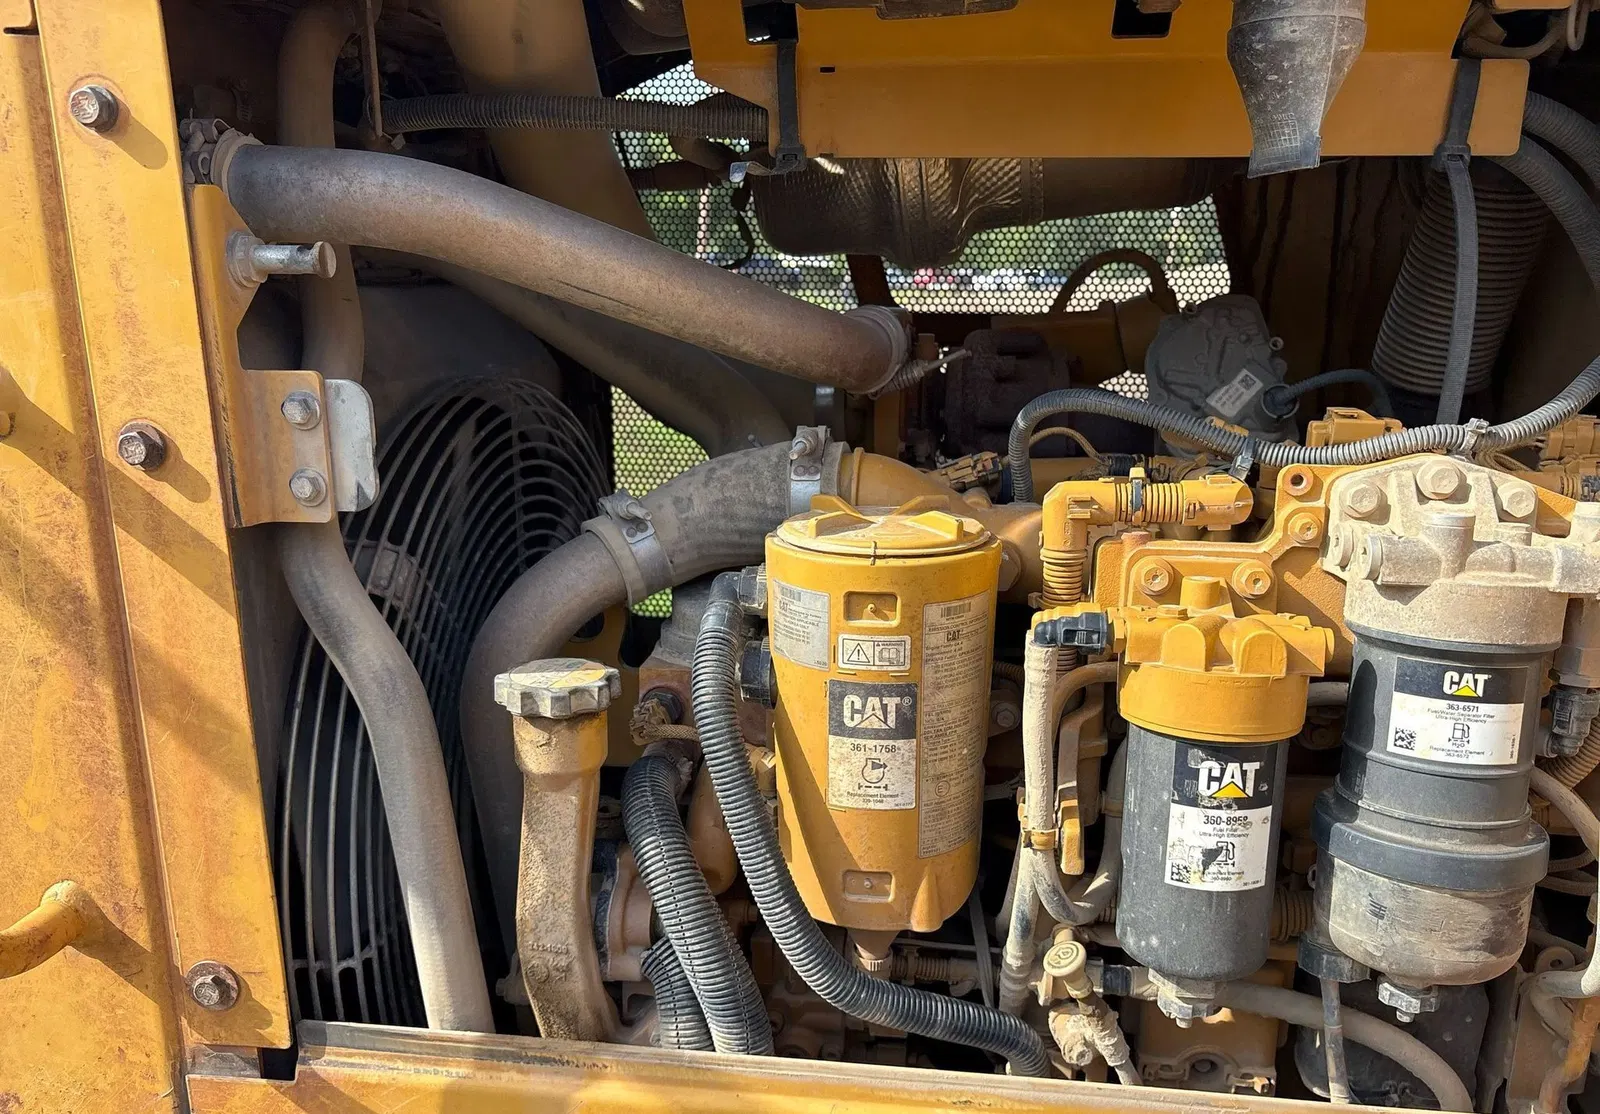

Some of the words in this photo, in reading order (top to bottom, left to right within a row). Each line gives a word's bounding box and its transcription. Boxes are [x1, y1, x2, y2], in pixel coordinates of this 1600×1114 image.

[1443, 671, 1488, 697] CAT
[1446, 703, 1479, 712] 363-6571
[850, 742, 897, 753] 361-1758
[1199, 760, 1260, 798] CAT
